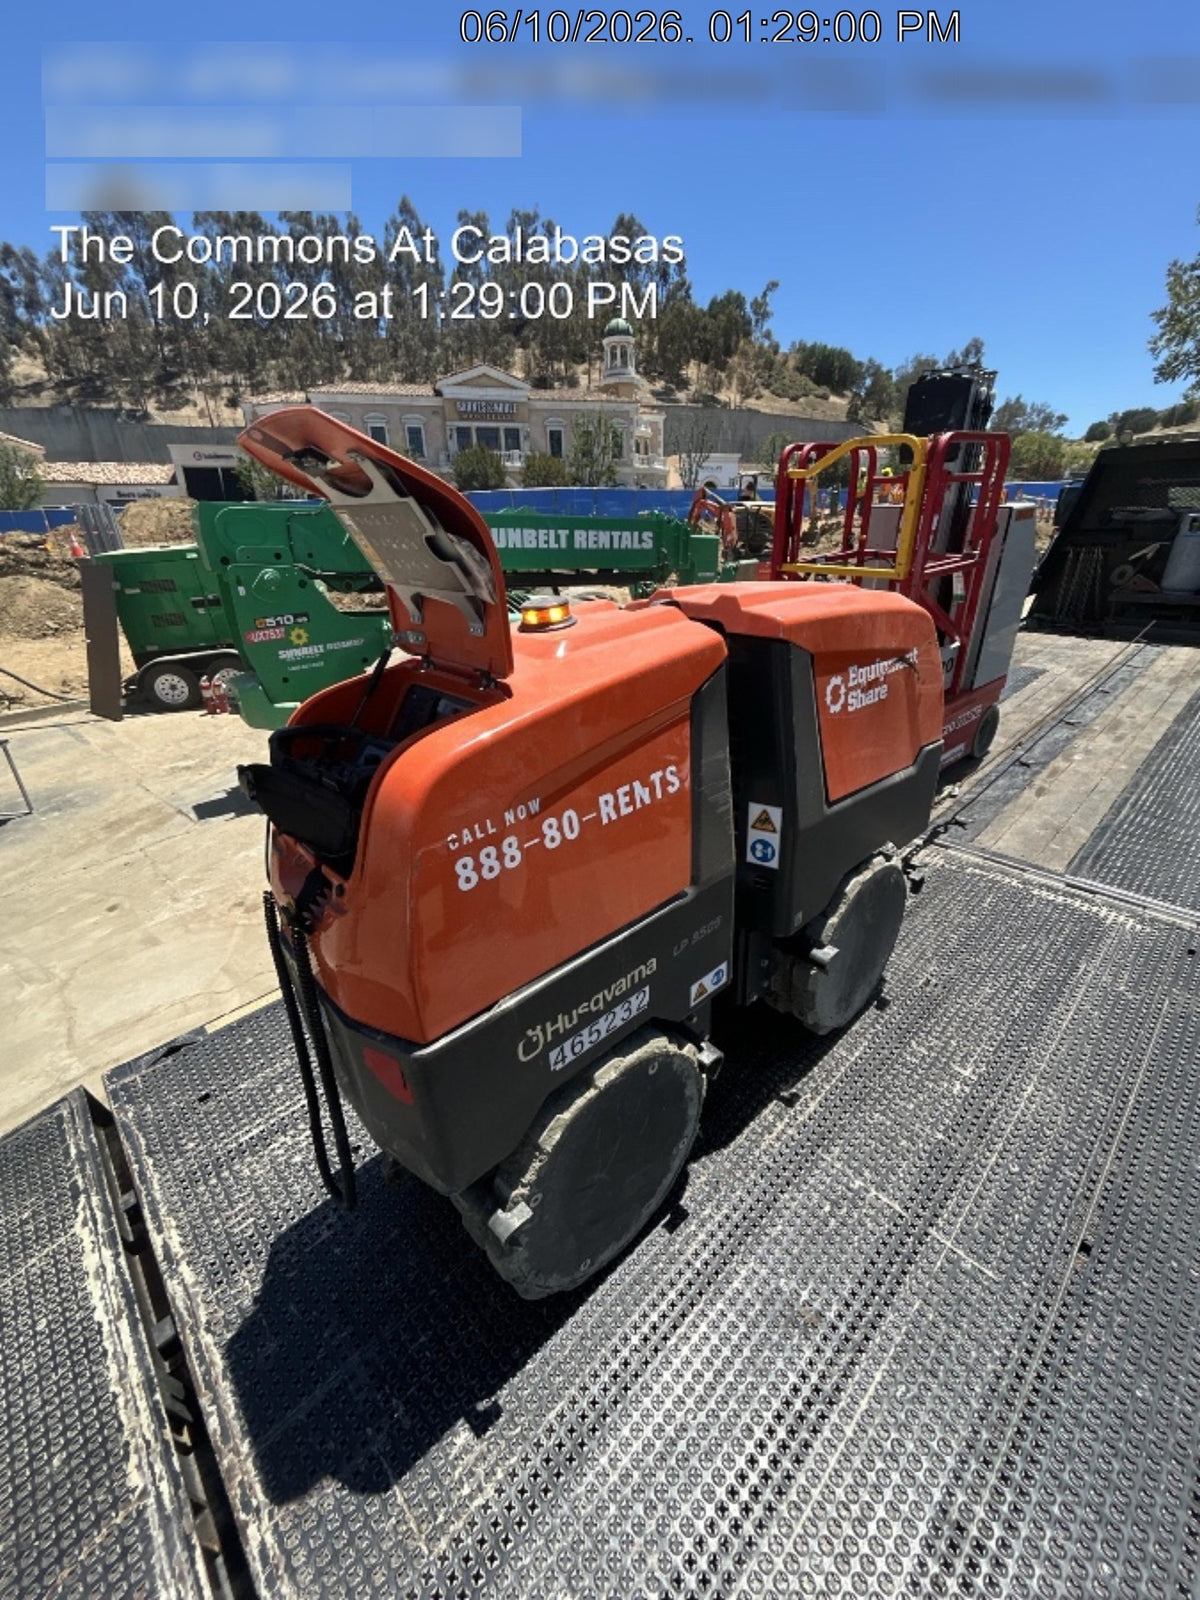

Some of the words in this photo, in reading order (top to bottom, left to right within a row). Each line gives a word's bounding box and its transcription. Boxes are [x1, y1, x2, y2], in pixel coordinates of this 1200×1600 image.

[490, 527, 569, 549] UNBELT
[574, 530, 653, 549] RENTALS
[847, 647, 919, 687] Equipmnt
[847, 683, 888, 712] Share
[447, 818, 497, 850] CALL
[504, 797, 541, 826] NOW
[454, 765, 681, 891] 888-80-RENTS
[546, 957, 657, 1042] Husqvarna
[552, 989, 648, 1069] 465232
